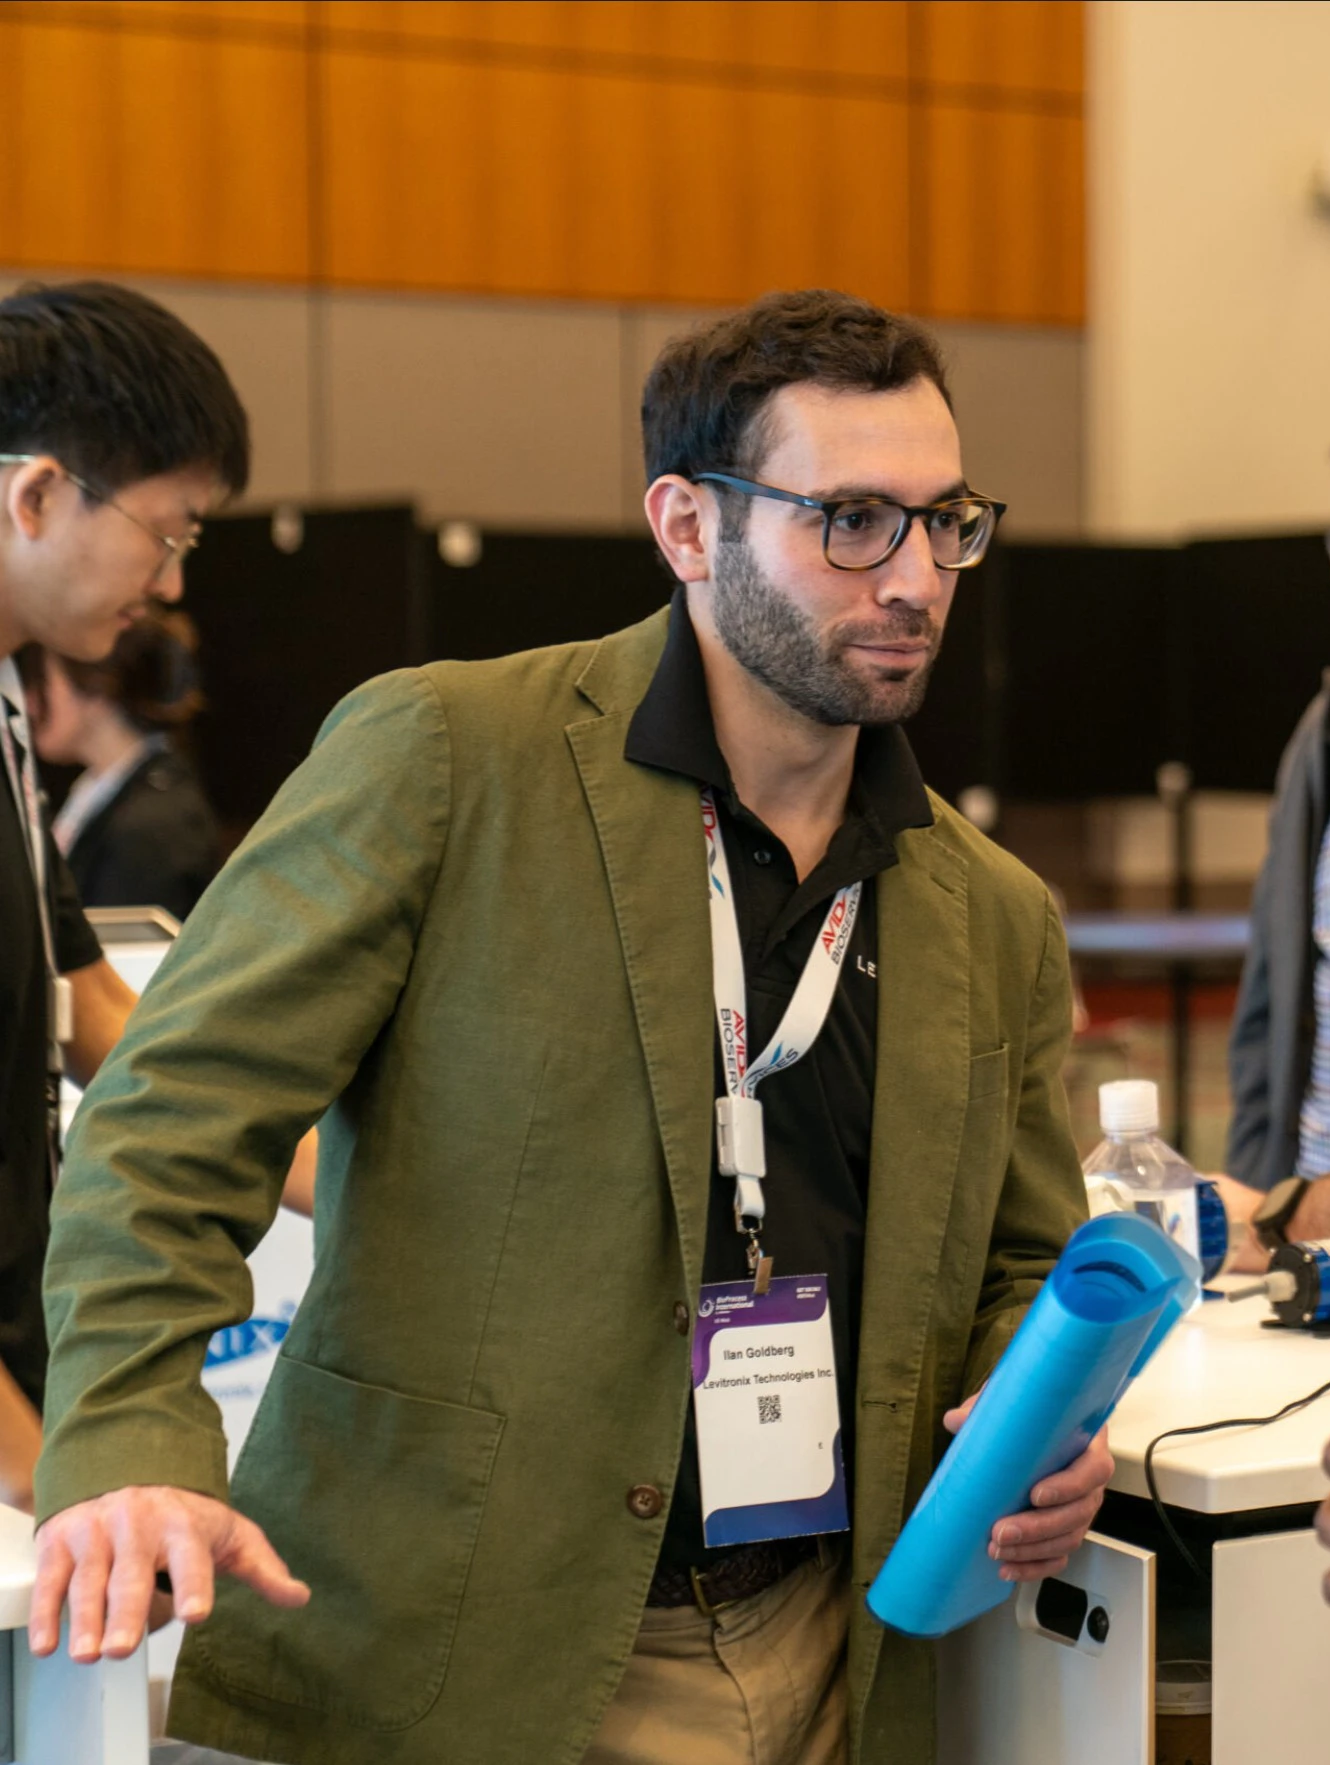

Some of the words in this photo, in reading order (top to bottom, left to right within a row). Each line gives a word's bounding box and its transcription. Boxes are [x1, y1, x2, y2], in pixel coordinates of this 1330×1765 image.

[821, 899, 847, 955] AVID
[723, 1349, 744, 1361] Ilan
[745, 1345, 795, 1359] Goldberg
[703, 1376, 751, 1390] Levitronix
[753, 1370, 815, 1384] Technologies
[817, 1368, 834, 1378] Inc.
